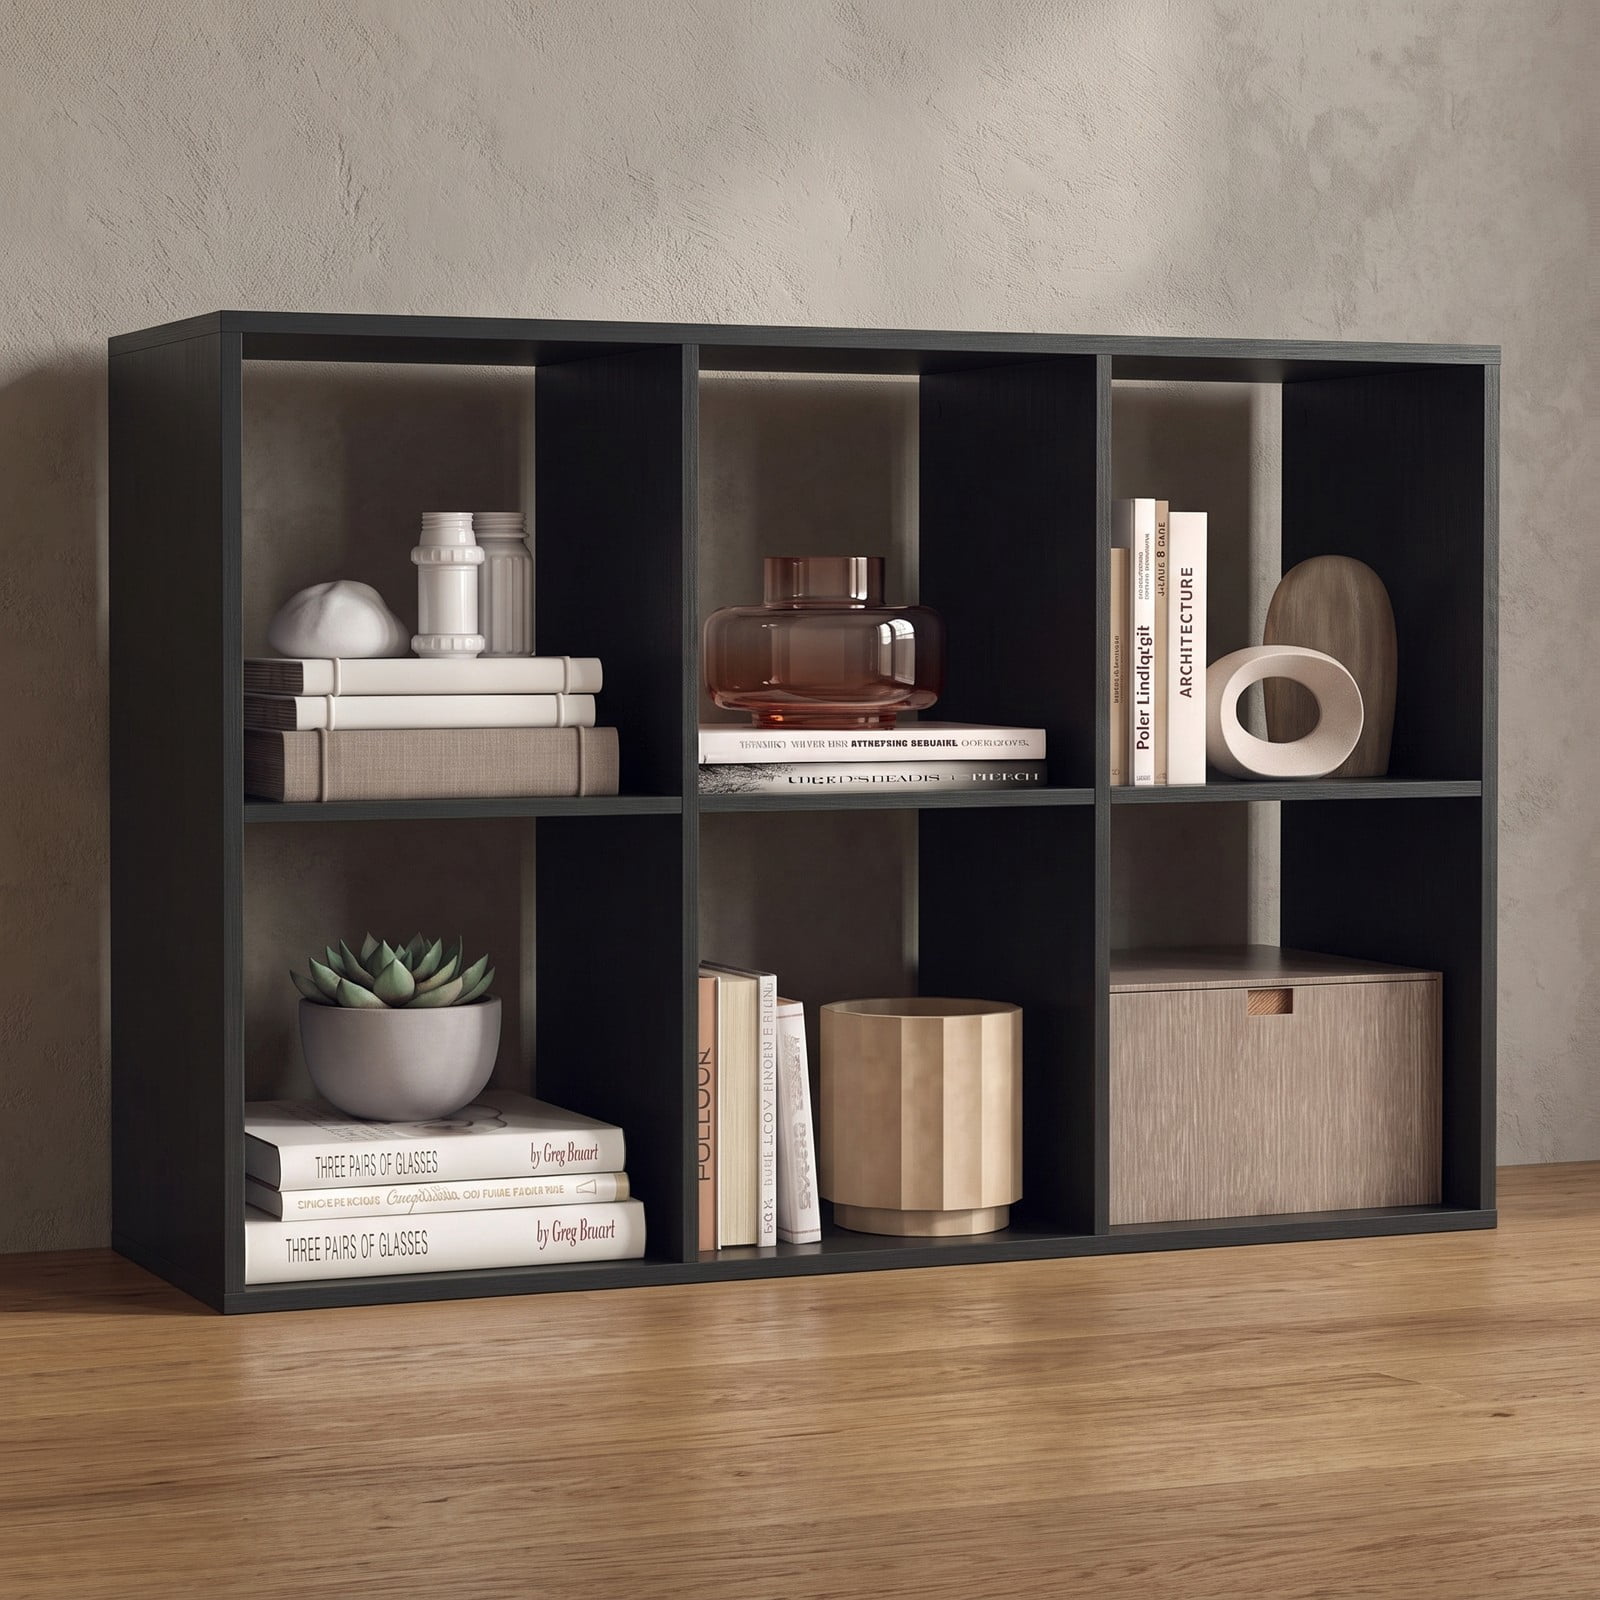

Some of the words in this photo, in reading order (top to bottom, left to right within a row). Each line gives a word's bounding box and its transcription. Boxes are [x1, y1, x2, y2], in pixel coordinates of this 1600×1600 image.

[1180, 567, 1193, 698] ARCHITECTURE
[1136, 710, 1150, 750] Poler
[315, 1155, 346, 1179] THREE
[349, 1153, 377, 1177] PAIRS
[379, 1152, 392, 1175] OF
[395, 1150, 438, 1175] GLASSES
[530, 1142, 542, 1169] by
[543, 1142, 565, 1167] Greg
[286, 1236, 321, 1263] THREE
[324, 1233, 357, 1261] PAIRS
[360, 1233, 375, 1259] OF
[378, 1230, 428, 1258] GLASSES
[536, 1219, 549, 1250] by
[552, 1219, 577, 1247] Greg
